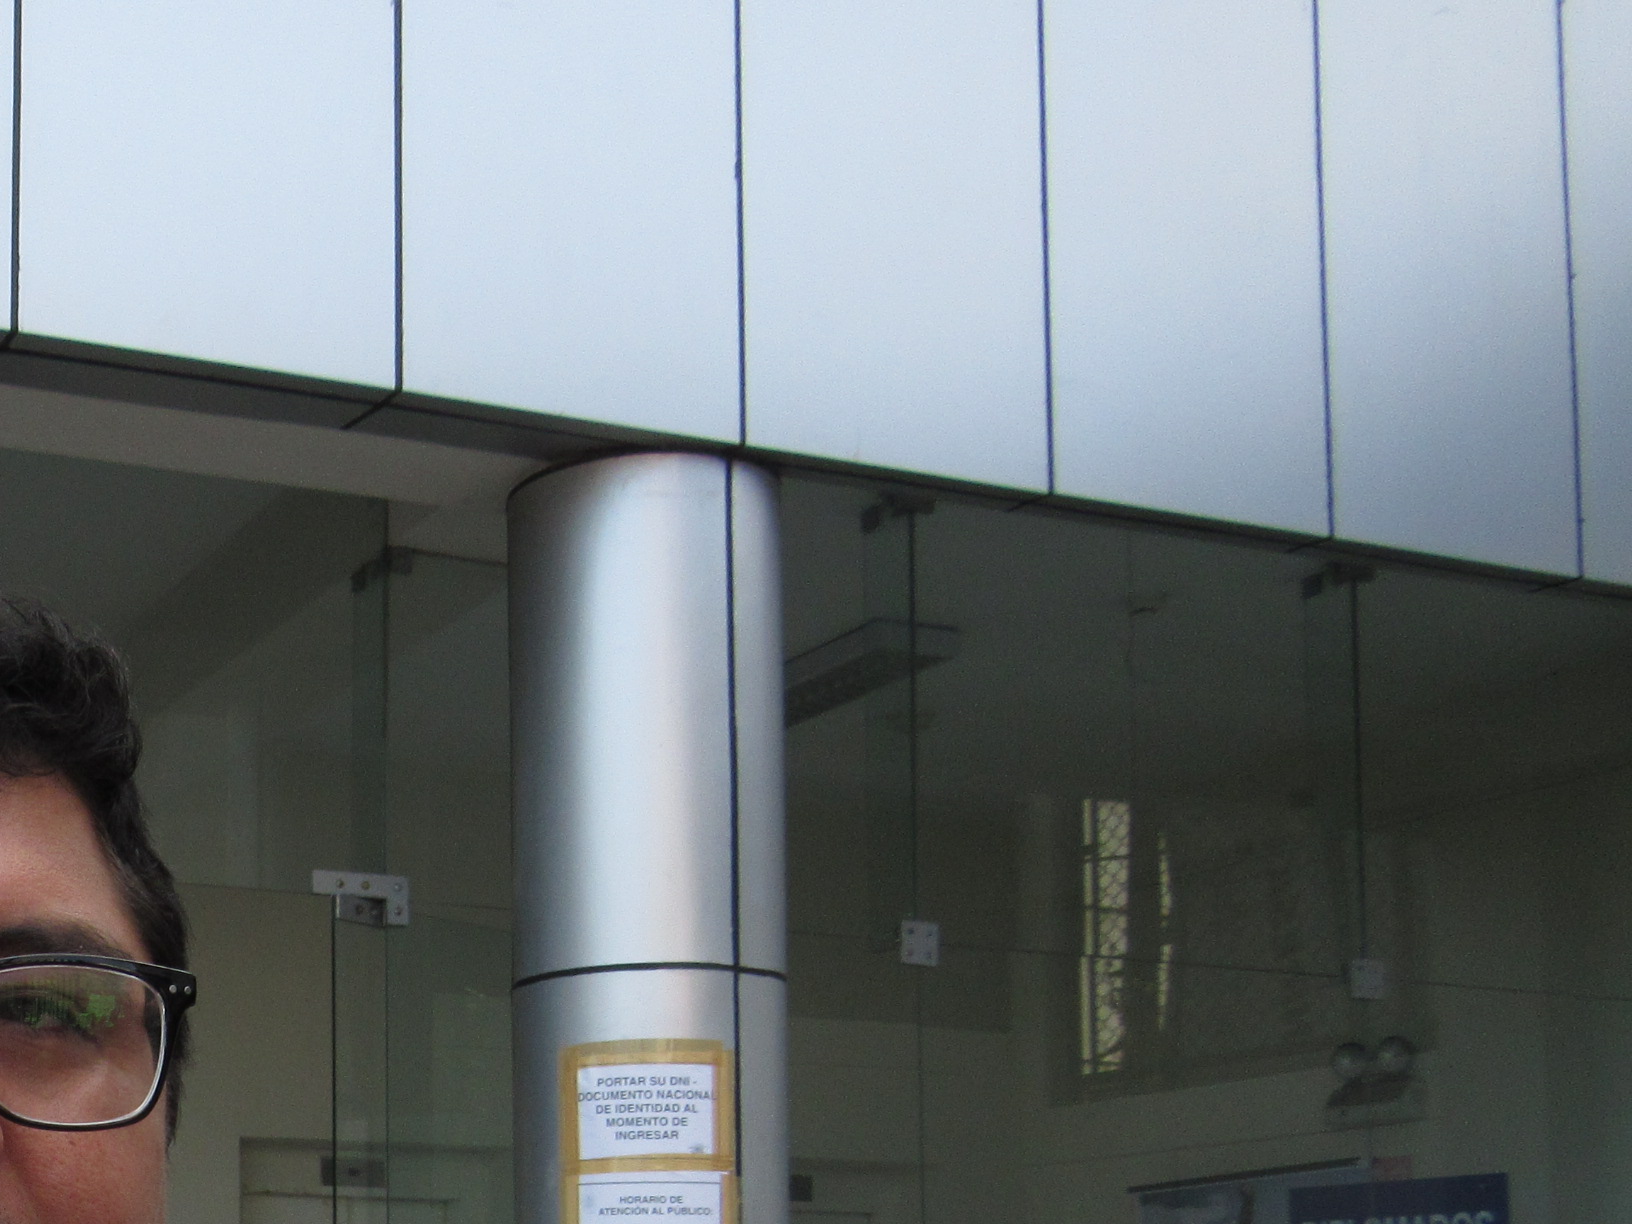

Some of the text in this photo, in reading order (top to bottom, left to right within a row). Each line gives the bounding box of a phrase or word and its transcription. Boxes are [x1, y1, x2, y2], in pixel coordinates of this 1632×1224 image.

[597, 1077, 646, 1087] PORTAR
[650, 1077, 666, 1086] SU
[670, 1077, 690, 1086] DNI
[578, 1090, 717, 1102] DOCUMENTO NACIONAL
[596, 1104, 699, 1114] DE IDENTIDAD AL
[606, 1117, 688, 1127] MOMENTO DE
[615, 1130, 679, 1140] INGRESAR
[619, 1195, 683, 1204] HORARIO DE
[598, 1205, 648, 1216] ATENCIÓN
[651, 1207, 664, 1215] AL
